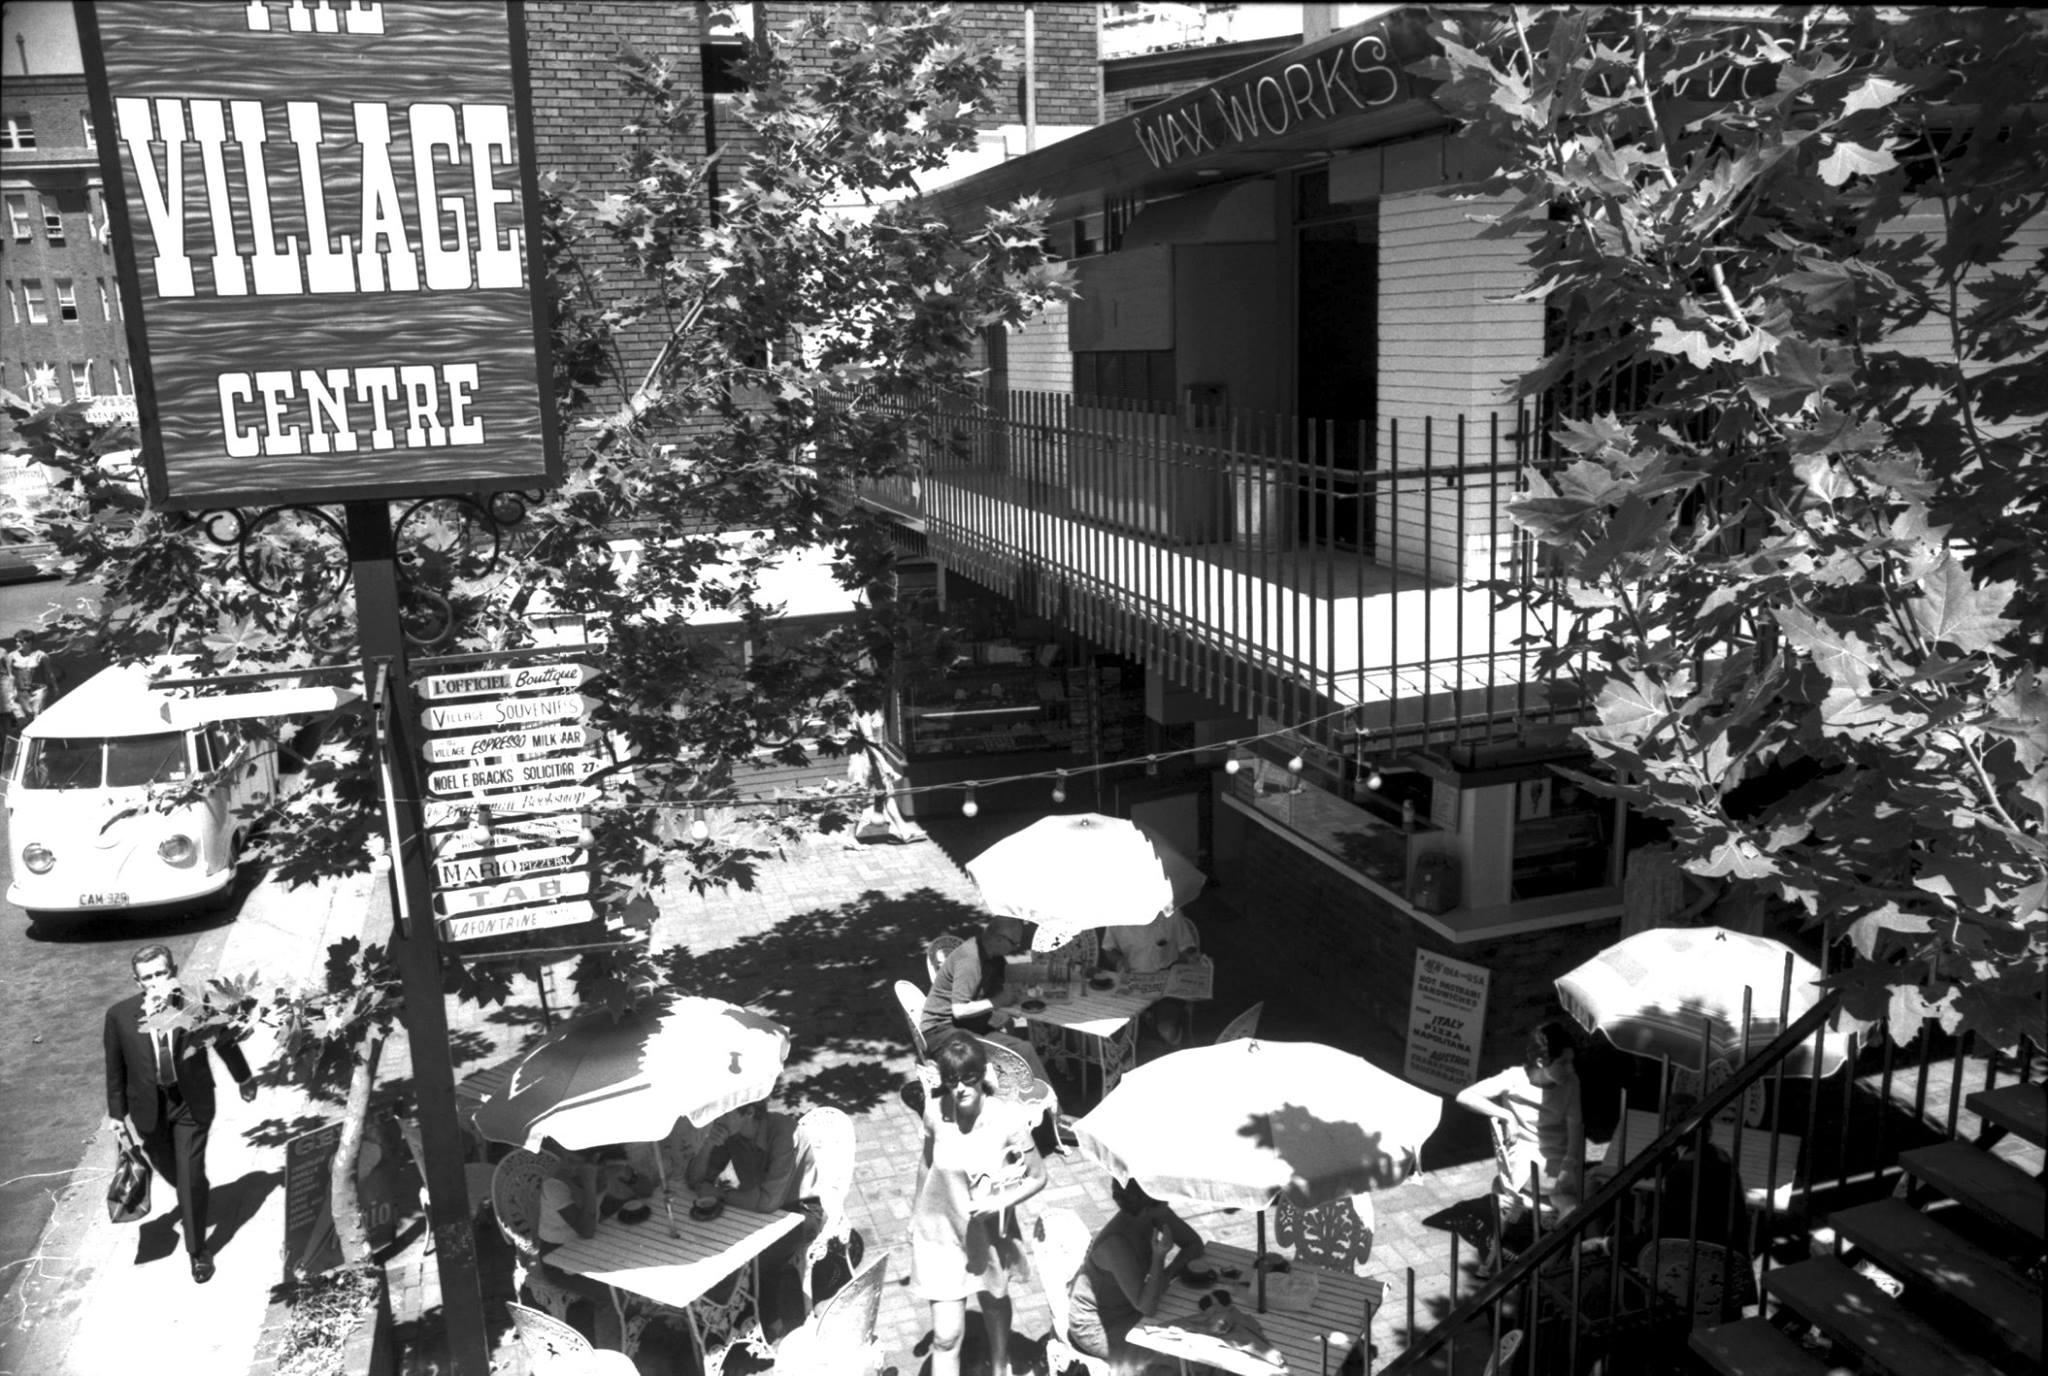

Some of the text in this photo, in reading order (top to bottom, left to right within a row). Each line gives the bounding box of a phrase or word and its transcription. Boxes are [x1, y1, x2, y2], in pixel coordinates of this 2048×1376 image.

[1133, 103, 1215, 168] WAX
[1210, 36, 1398, 143] WORKS
[115, 96, 524, 298] VILLAGE
[217, 363, 485, 458] CENTRE
[434, 667, 578, 695] L'OFFICIEL Boutique
[470, 733, 527, 756] ESPRESSO
[532, 733, 556, 748] MILK
[433, 775, 458, 791] NOEL
[472, 769, 514, 786] BRACKS
[79, 893, 104, 906] CAM
[1431, 1015, 1465, 1030] ITALY
